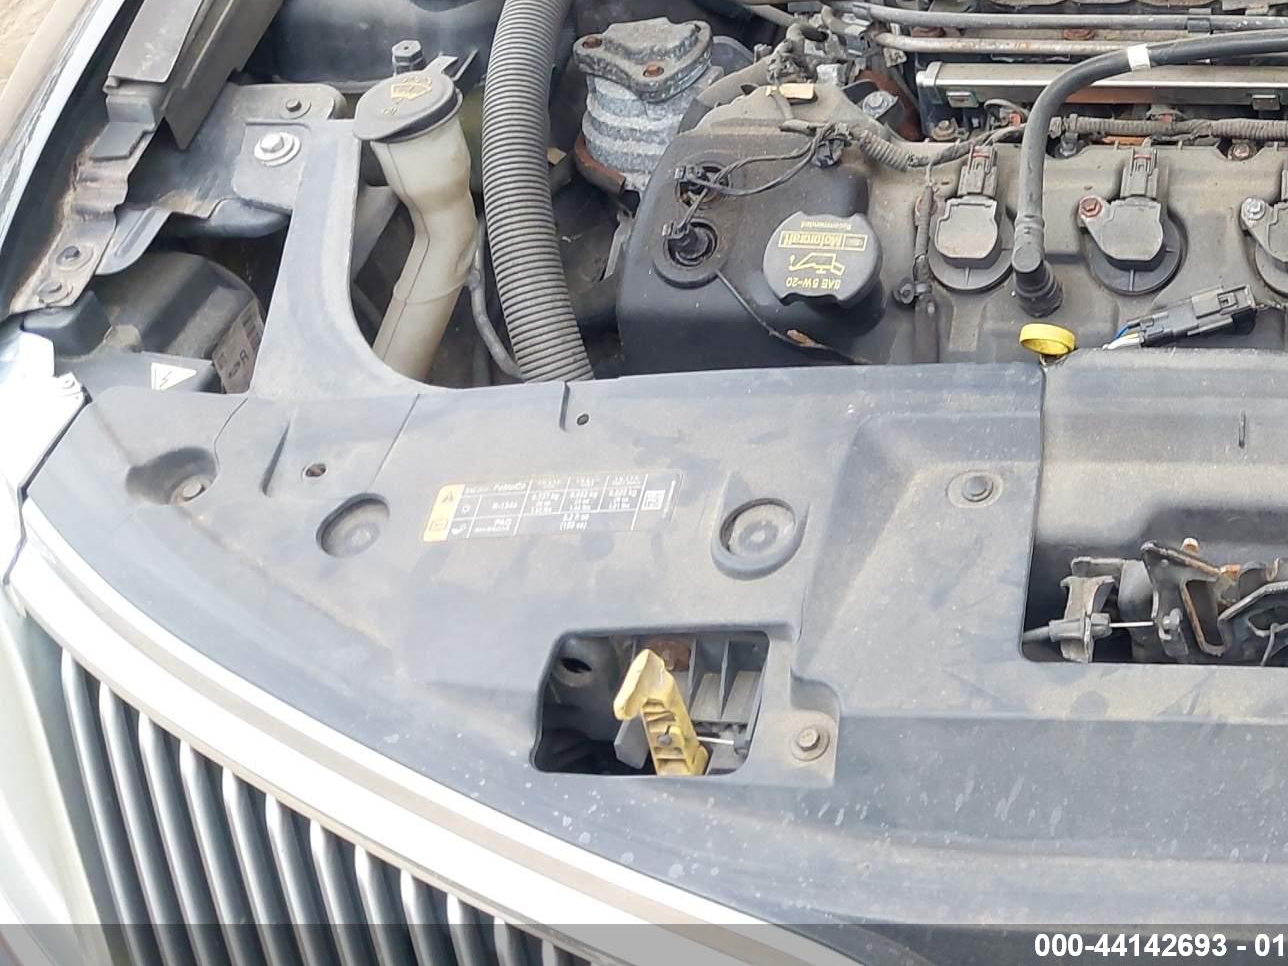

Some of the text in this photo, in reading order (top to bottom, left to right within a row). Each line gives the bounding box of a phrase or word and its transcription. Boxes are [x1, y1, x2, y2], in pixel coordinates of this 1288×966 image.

[783, 233, 842, 248] Motorcraft
[785, 276, 842, 291] SAE 5W-20
